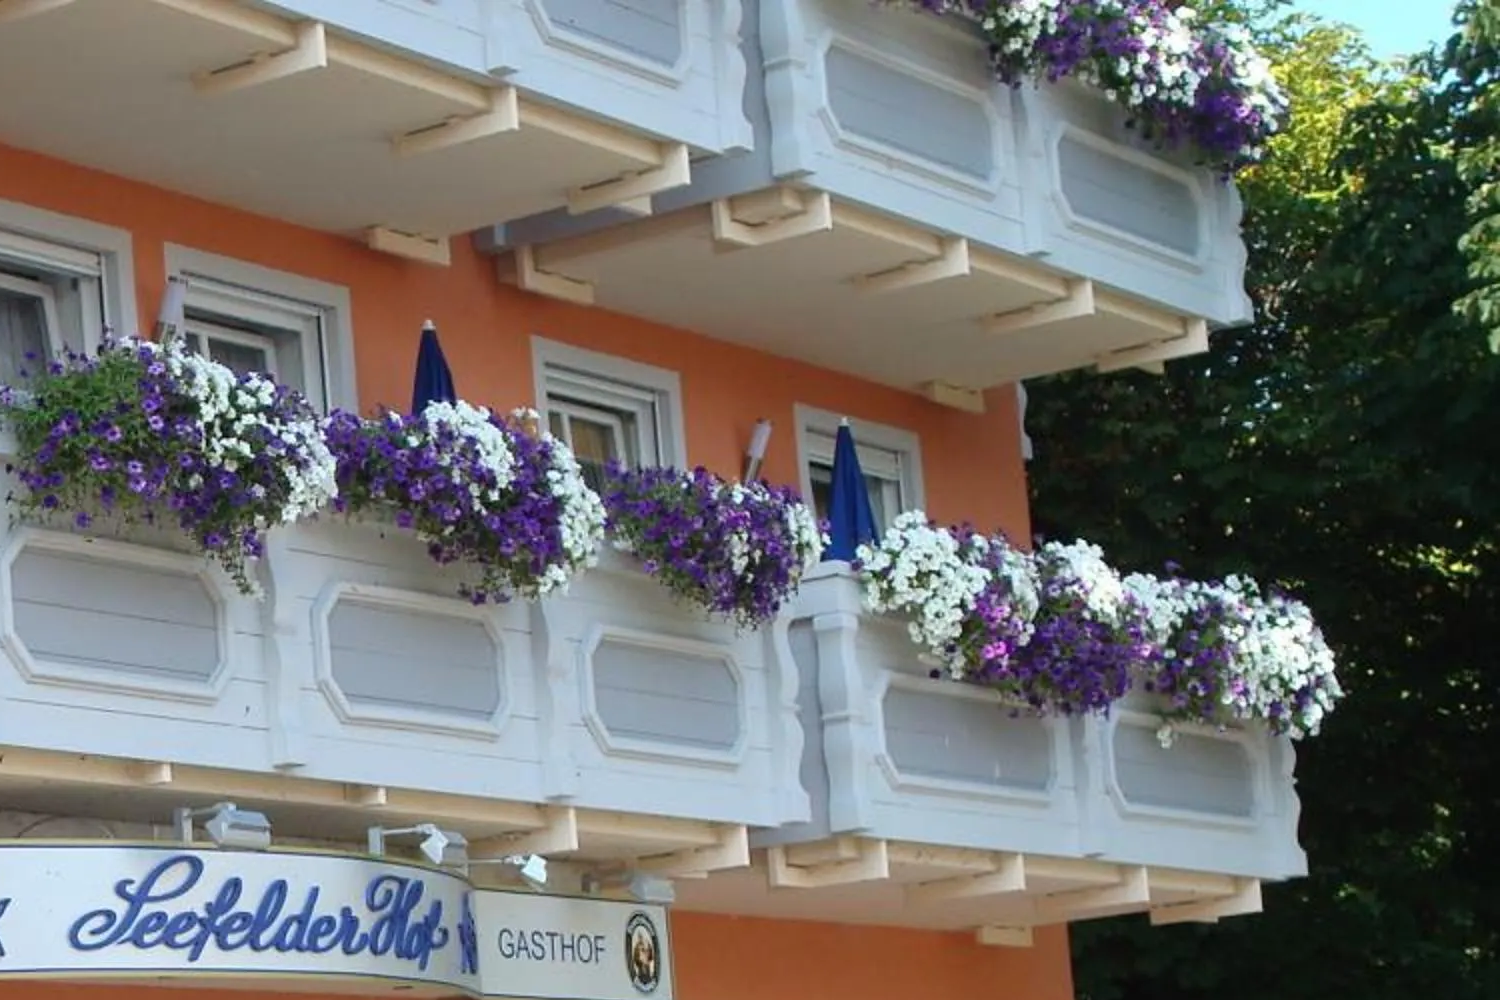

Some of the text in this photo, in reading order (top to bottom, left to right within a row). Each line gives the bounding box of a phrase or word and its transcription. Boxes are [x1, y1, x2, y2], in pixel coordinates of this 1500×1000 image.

[70, 855, 449, 971] Seefelder Hof
[498, 927, 606, 965] GASTHOF
